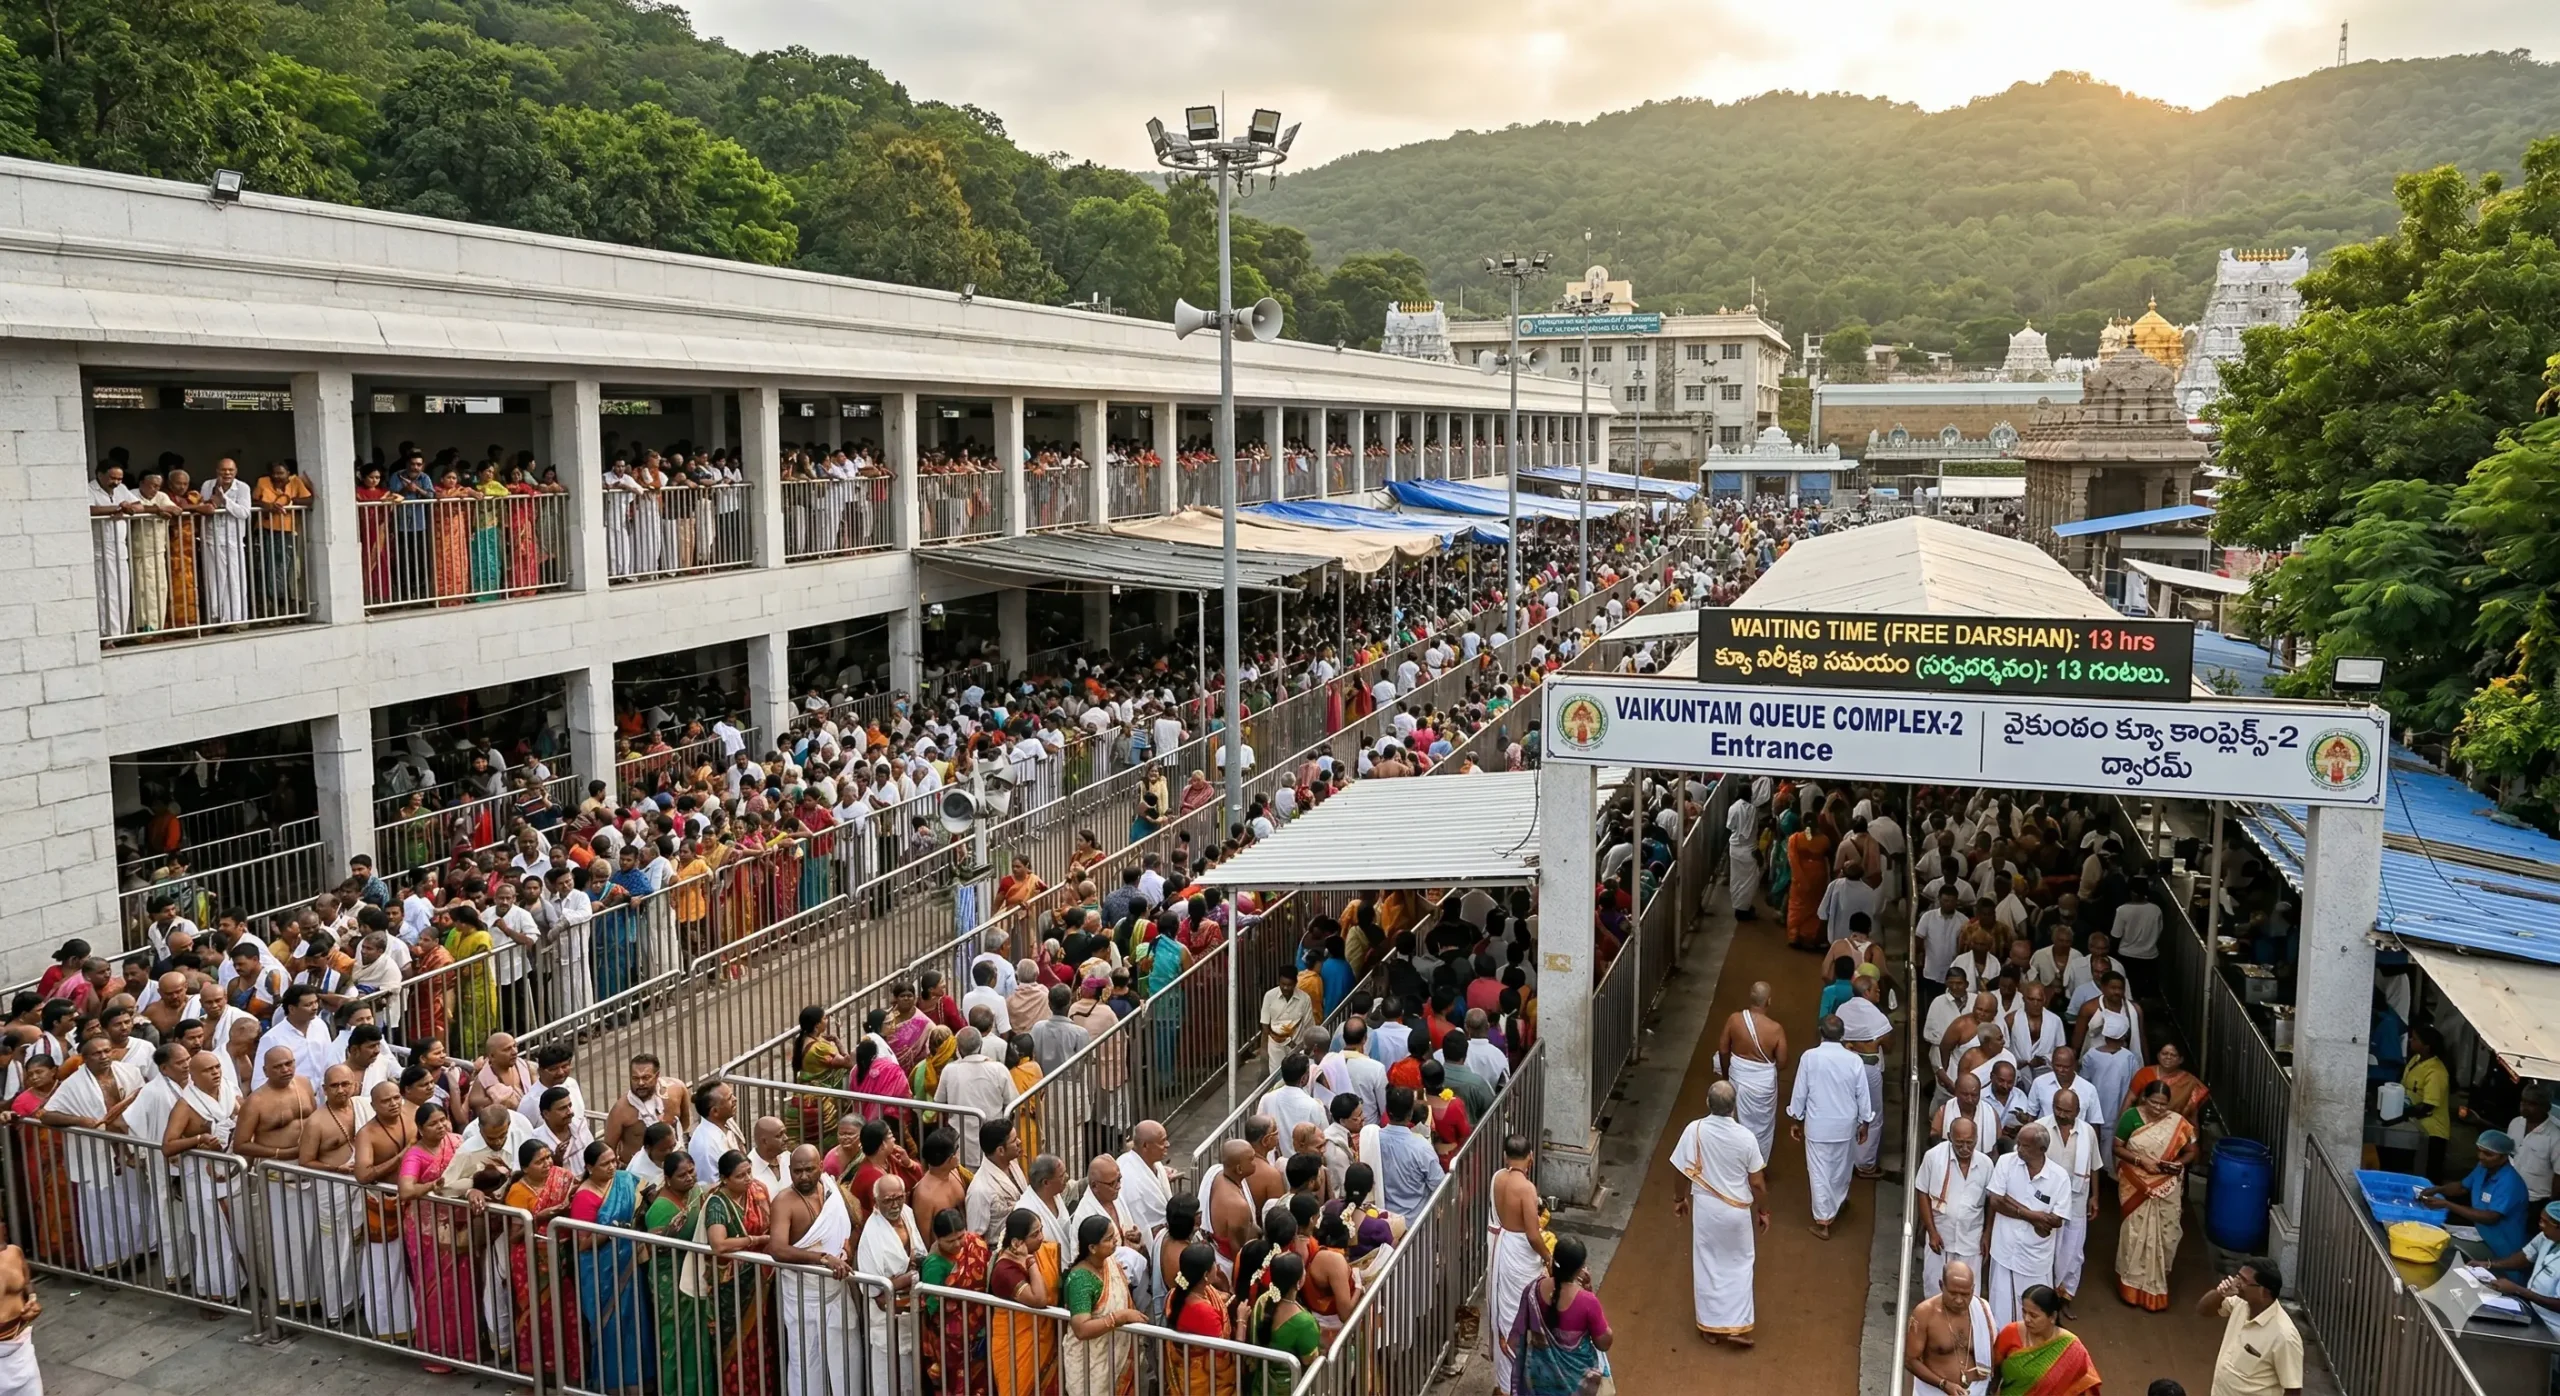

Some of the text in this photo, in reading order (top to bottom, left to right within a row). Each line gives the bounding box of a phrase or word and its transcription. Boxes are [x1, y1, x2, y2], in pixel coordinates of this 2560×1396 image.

[1731, 617, 2156, 654] WAITING TIME (FREE DARSHAN): 13 hrs
[1714, 646, 1753, 676] క్యూ
[1756, 644, 1819, 678] నిరీక్షణ
[1823, 650, 1911, 674] సమయం
[2056, 659, 2082, 681] 13
[2088, 661, 2171, 684] గంటలు.
[1615, 696, 1742, 726] VAIKUNTAM
[1749, 702, 1826, 730] QUEUE
[1832, 705, 1963, 736] COMPLEX-2
[1711, 731, 1833, 762] Entrance
[2114, 717, 2164, 752] క్యూ
[2169, 718, 2299, 757] కాంప్లెక్స్-2
[2101, 751, 2193, 786] ద్వారమ్
